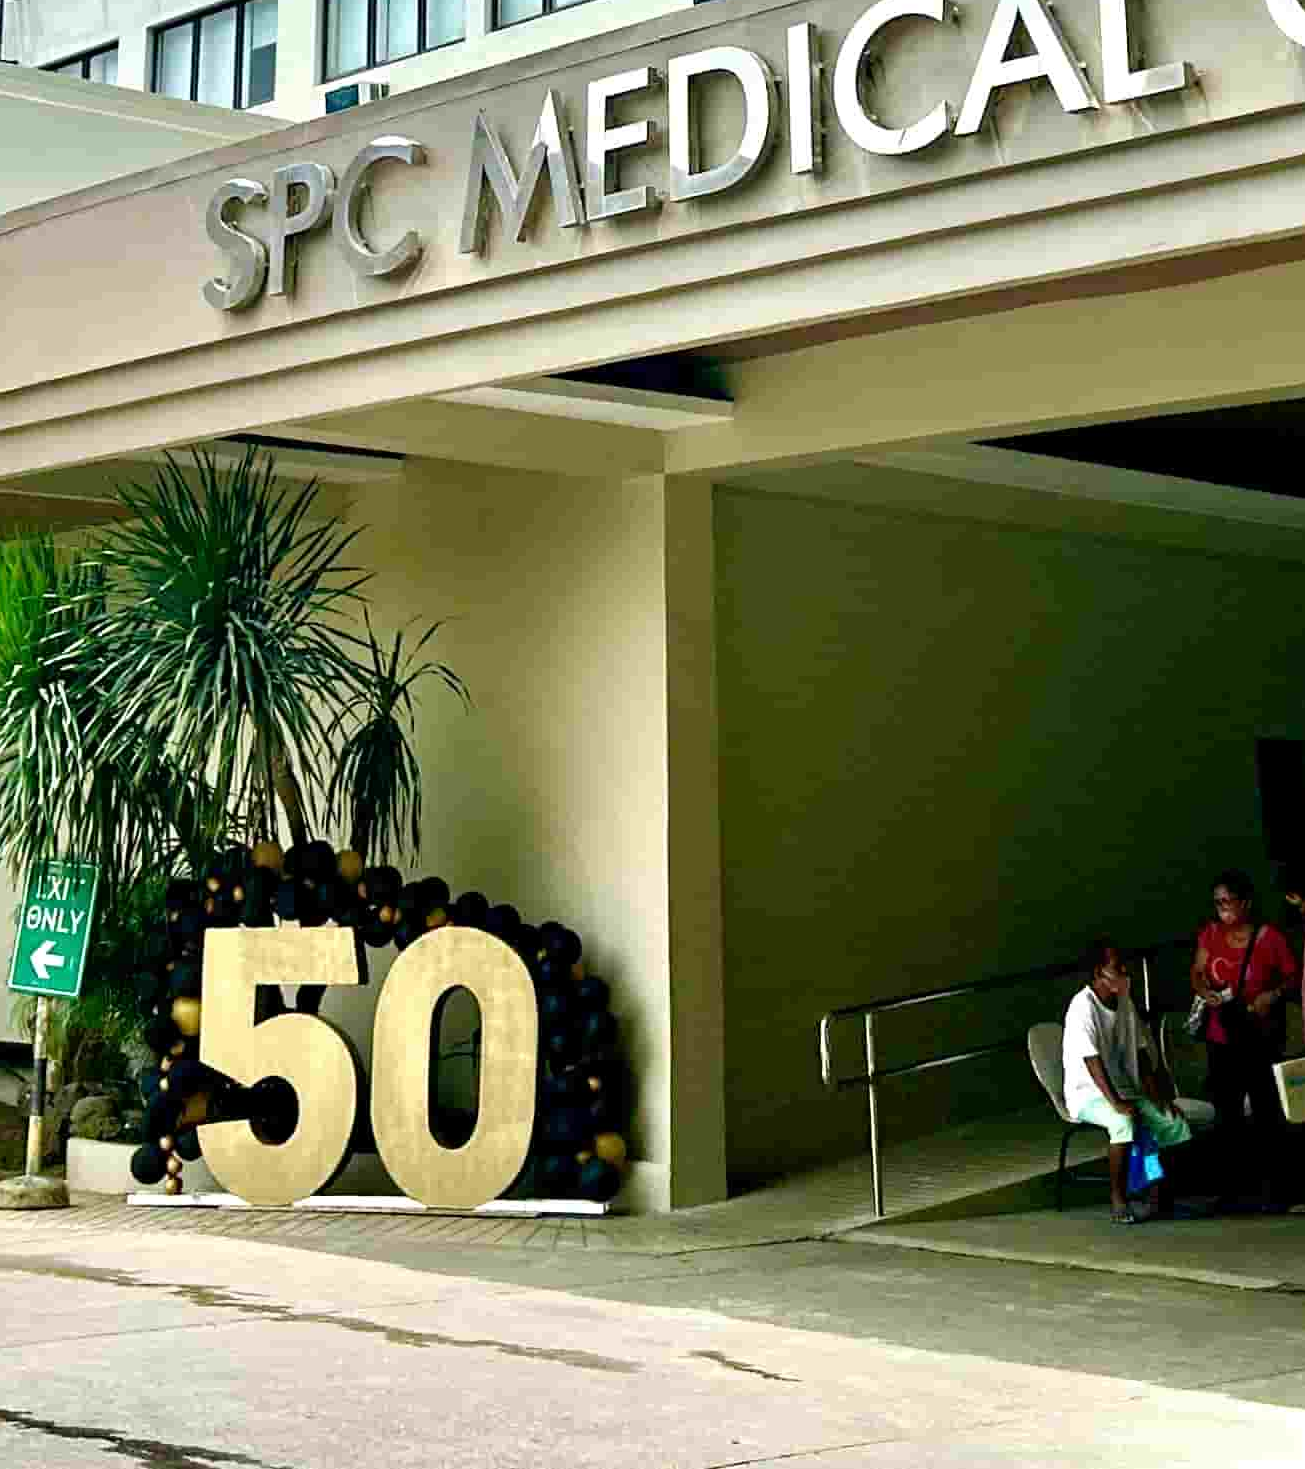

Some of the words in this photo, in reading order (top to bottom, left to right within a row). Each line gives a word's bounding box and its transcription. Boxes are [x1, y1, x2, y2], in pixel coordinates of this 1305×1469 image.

[201, 134, 428, 311] SPC
[25, 904, 86, 935] ONLY
[35, 875, 86, 901] EXI
[195, 926, 539, 1210] 50
